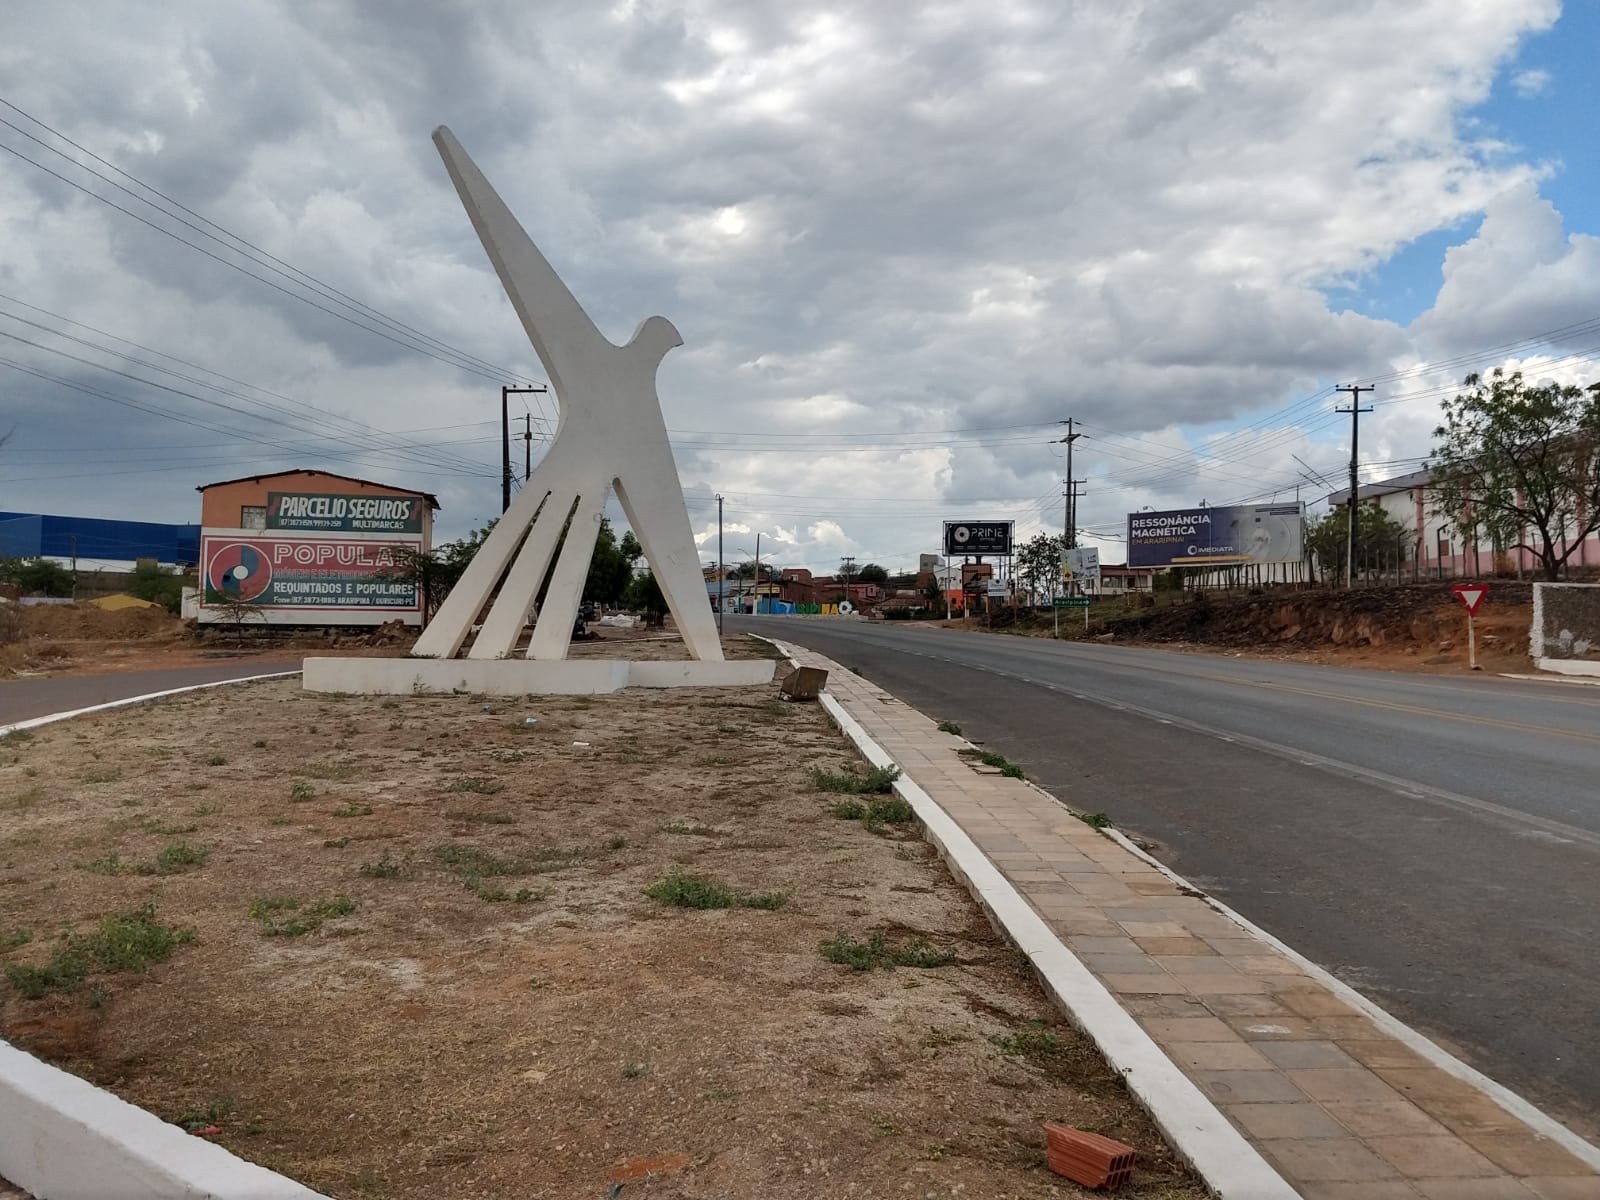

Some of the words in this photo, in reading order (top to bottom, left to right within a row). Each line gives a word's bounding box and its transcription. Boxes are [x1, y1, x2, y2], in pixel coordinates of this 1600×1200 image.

[347, 498, 411, 520] SEGUROS
[352, 520, 404, 529] MULTIMARCAS
[1132, 514, 1211, 528] RESSONÂNCIA
[971, 527, 1004, 537] PRIME
[1132, 525, 1196, 538] MAGNÉTICA
[274, 582, 342, 595] REQUINTADOS
[346, 583, 353, 594] E
[356, 584, 414, 595] POPULARES
